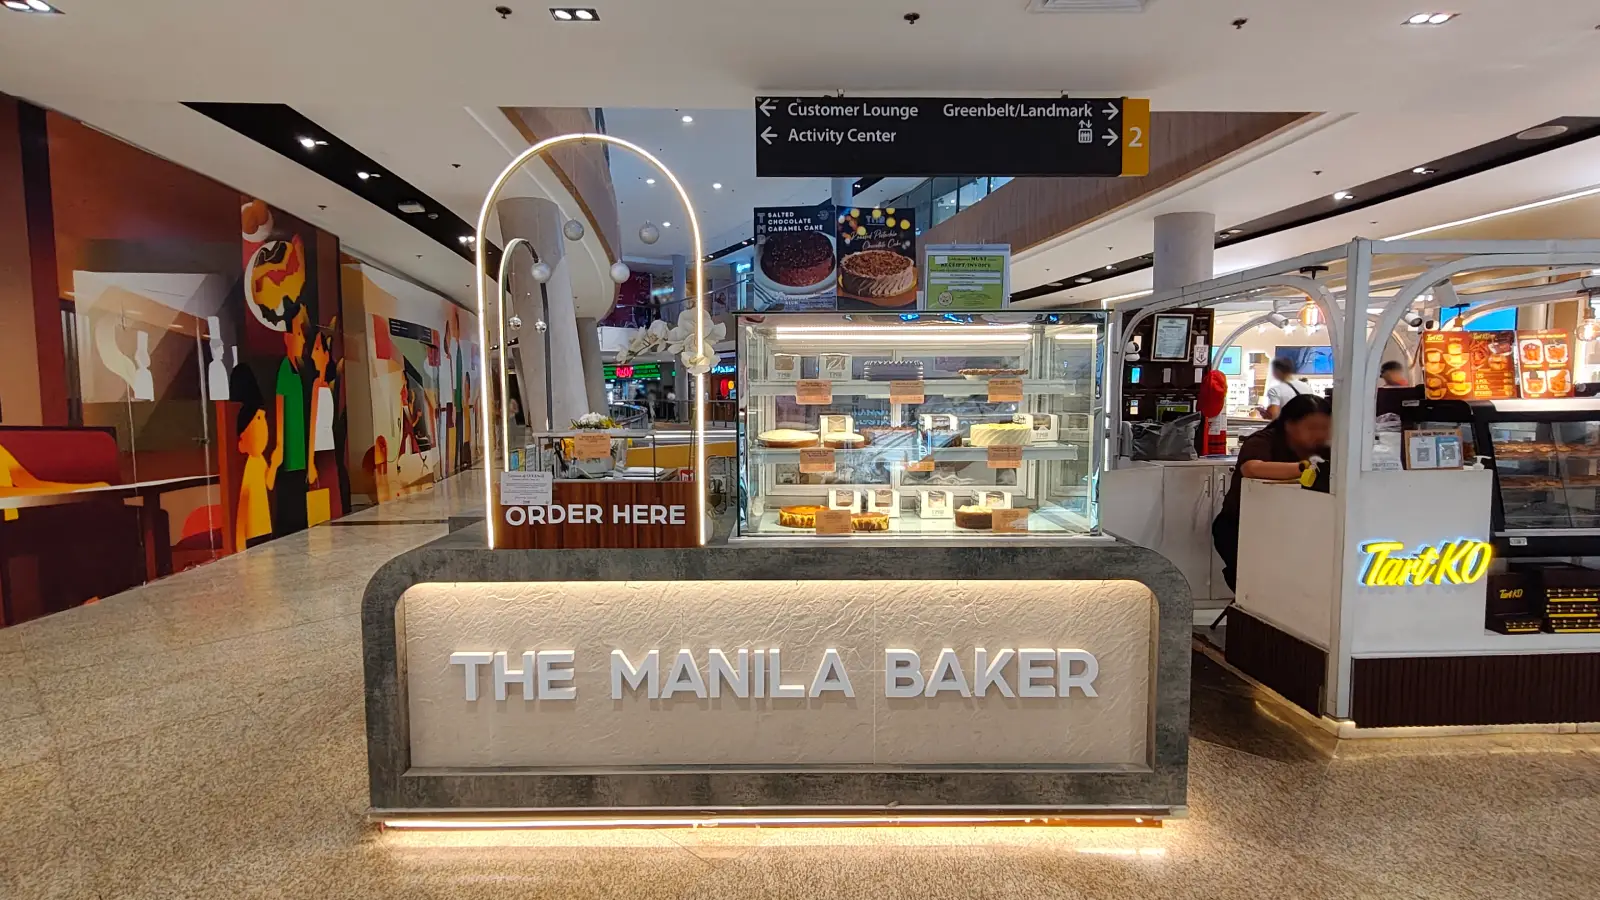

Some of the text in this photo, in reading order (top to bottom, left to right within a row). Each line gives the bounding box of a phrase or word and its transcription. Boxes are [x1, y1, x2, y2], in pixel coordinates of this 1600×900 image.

[787, 102, 919, 120] Customer Lounge
[943, 103, 1093, 118] Greenbelt/Landmark
[788, 128, 897, 145] Activity Center
[1128, 126, 1143, 148] 2
[505, 503, 686, 526] ORDER HERE
[450, 648, 1099, 701] THE MANILA BAKER
